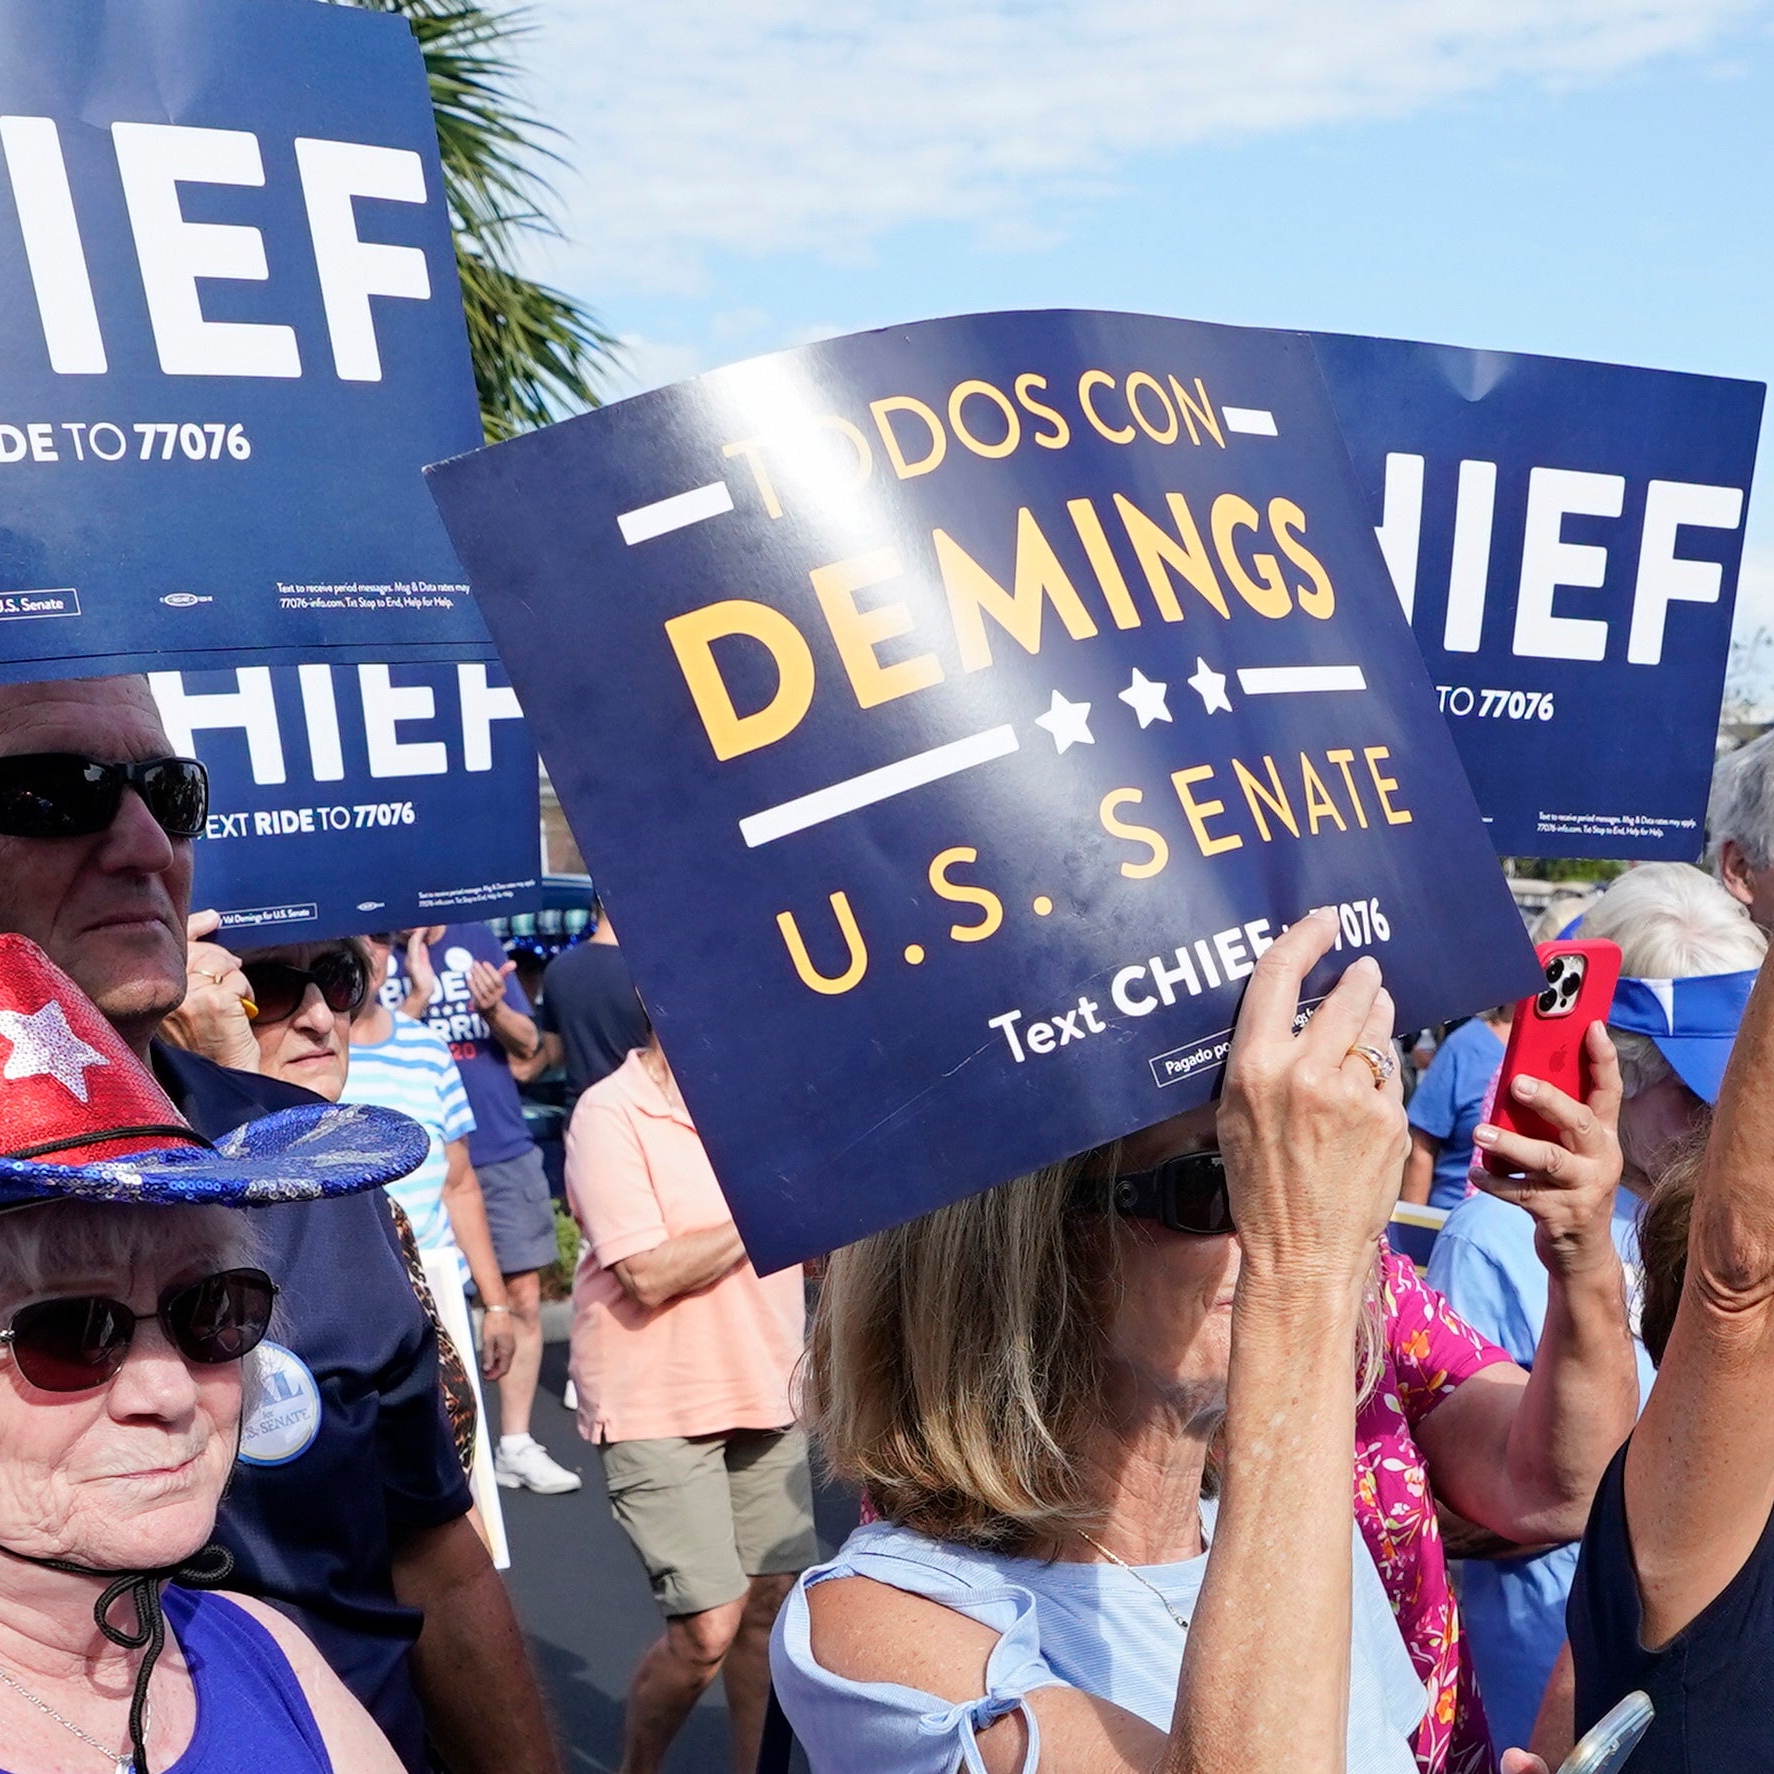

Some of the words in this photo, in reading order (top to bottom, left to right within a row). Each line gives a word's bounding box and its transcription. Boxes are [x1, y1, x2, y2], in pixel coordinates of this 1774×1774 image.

[62, 422, 127, 461] TO
[133, 422, 252, 461] 77076
[724, 372, 1071, 520] TODOS
[1078, 369, 1226, 450] CON
[21, 597, 64, 612] Senate
[664, 491, 1335, 762] DEMINGS
[1436, 685, 1474, 716] TO
[1478, 689, 1555, 722] 77076
[198, 812, 249, 840] EXT
[255, 809, 315, 835] RIDE
[317, 806, 351, 831] TO
[353, 801, 415, 828] 77076
[777, 846, 1053, 995] U.S.
[1100, 746, 1413, 879] SENATE
[988, 994, 1107, 1064] Text
[1111, 917, 1275, 1017] CHIEF
[1165, 1045, 1213, 1076] Pagado
